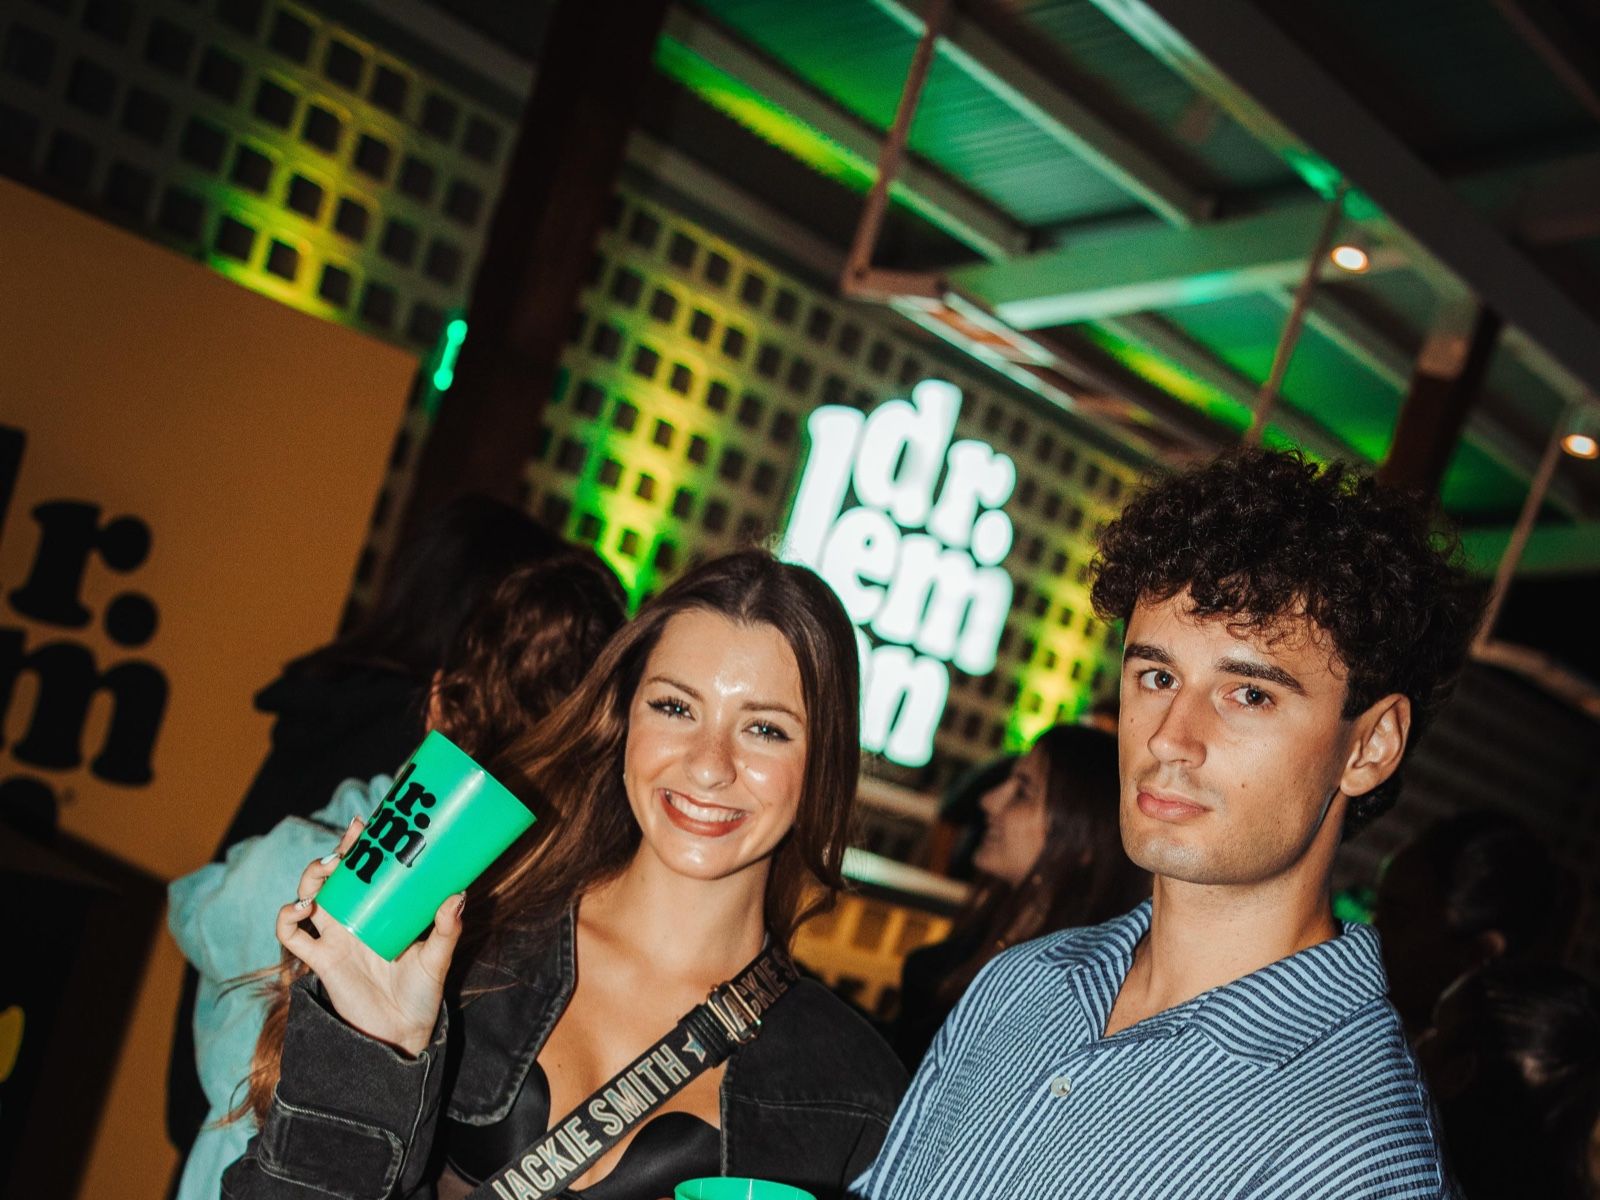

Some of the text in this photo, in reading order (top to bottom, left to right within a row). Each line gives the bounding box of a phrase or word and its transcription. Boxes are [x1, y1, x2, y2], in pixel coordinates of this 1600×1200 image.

[852, 378, 1016, 567] dr.
[0, 425, 159, 650] r.
[859, 629, 950, 768] n
[344, 839, 384, 884] n
[366, 806, 427, 868] m
[721, 956, 789, 1033] ACKIE
[589, 1044, 691, 1137] SMITH
